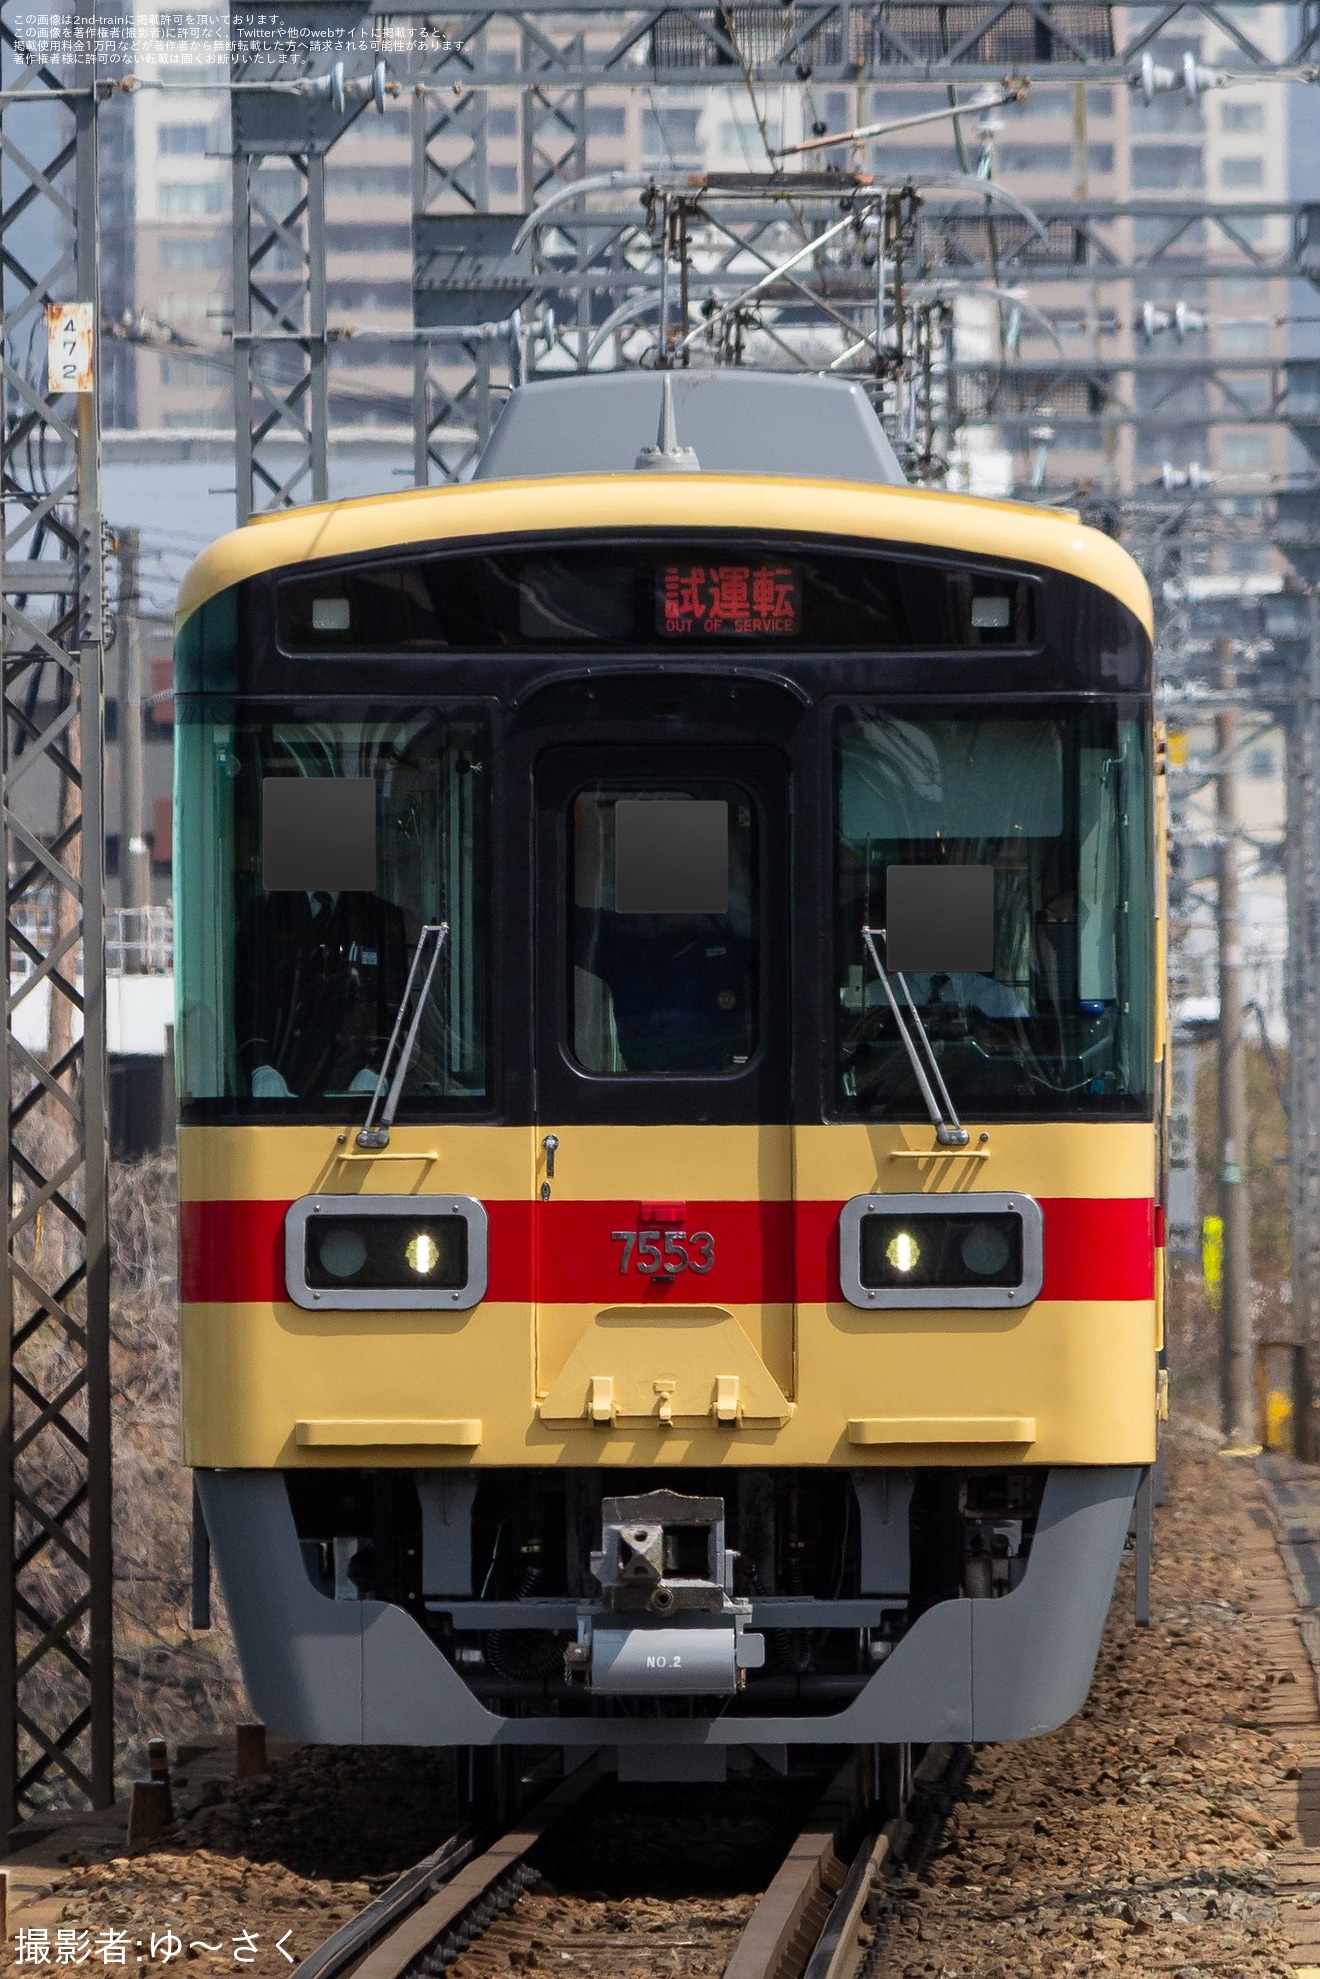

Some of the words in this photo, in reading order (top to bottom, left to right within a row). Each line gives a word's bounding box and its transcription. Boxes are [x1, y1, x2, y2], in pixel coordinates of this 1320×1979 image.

[664, 566, 795, 618] 試運転
[666, 619, 693, 632] OUT
[704, 619, 723, 632] OF
[734, 619, 793, 632] SERVICE
[611, 1231, 715, 1274] 7553
[646, 1656, 682, 1668] NO.2
